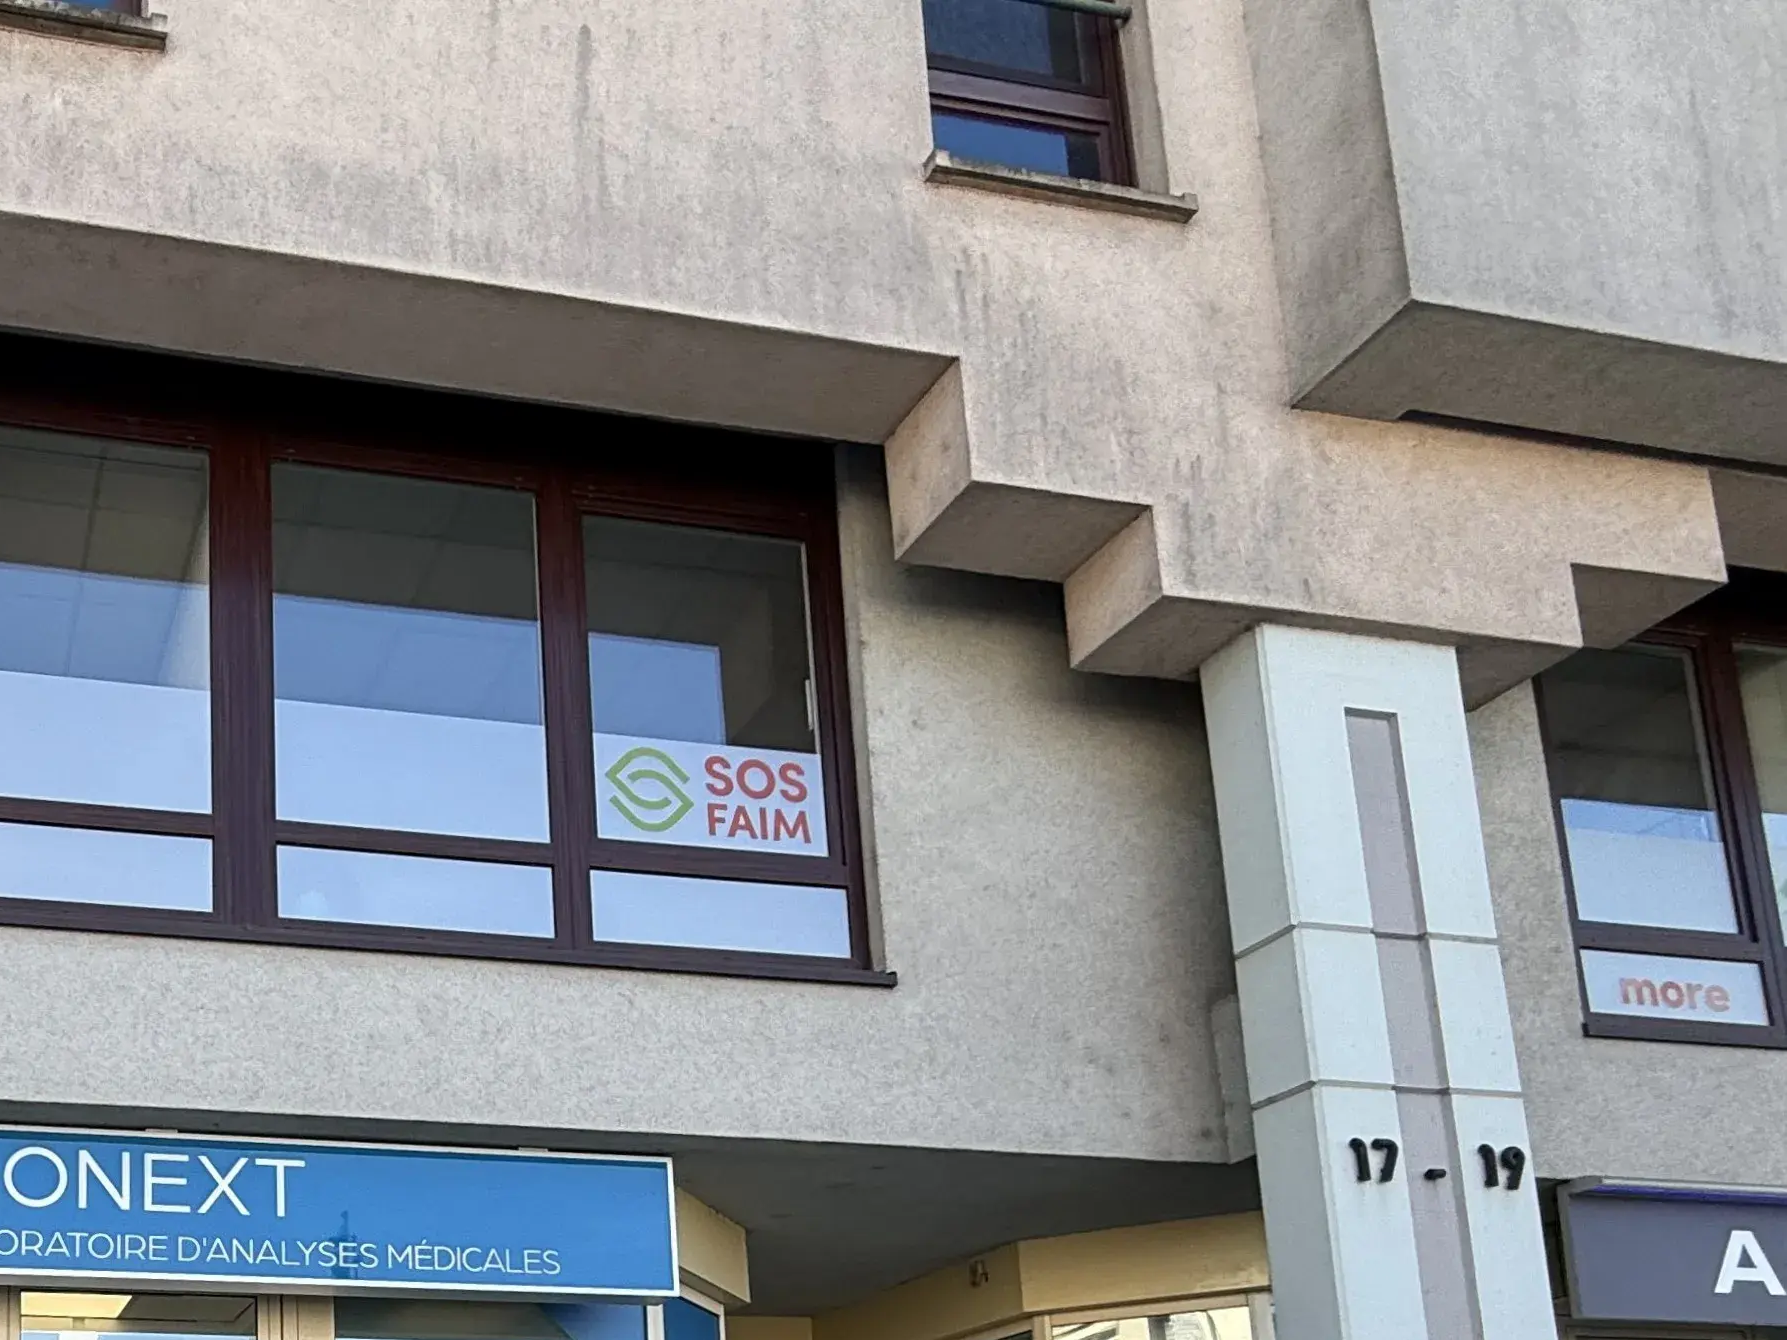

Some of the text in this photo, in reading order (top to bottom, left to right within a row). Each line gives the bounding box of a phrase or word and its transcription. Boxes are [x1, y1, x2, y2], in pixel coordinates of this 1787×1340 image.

[704, 755, 809, 803] SOS
[707, 802, 812, 844] FAIM
[1617, 976, 1731, 1014] more
[1349, 1138, 1398, 1183] 17
[1477, 1143, 1526, 1190] 19
[177, 1235, 380, 1270] D'ANALYSES
[387, 1238, 562, 1275] MÉDICALES
